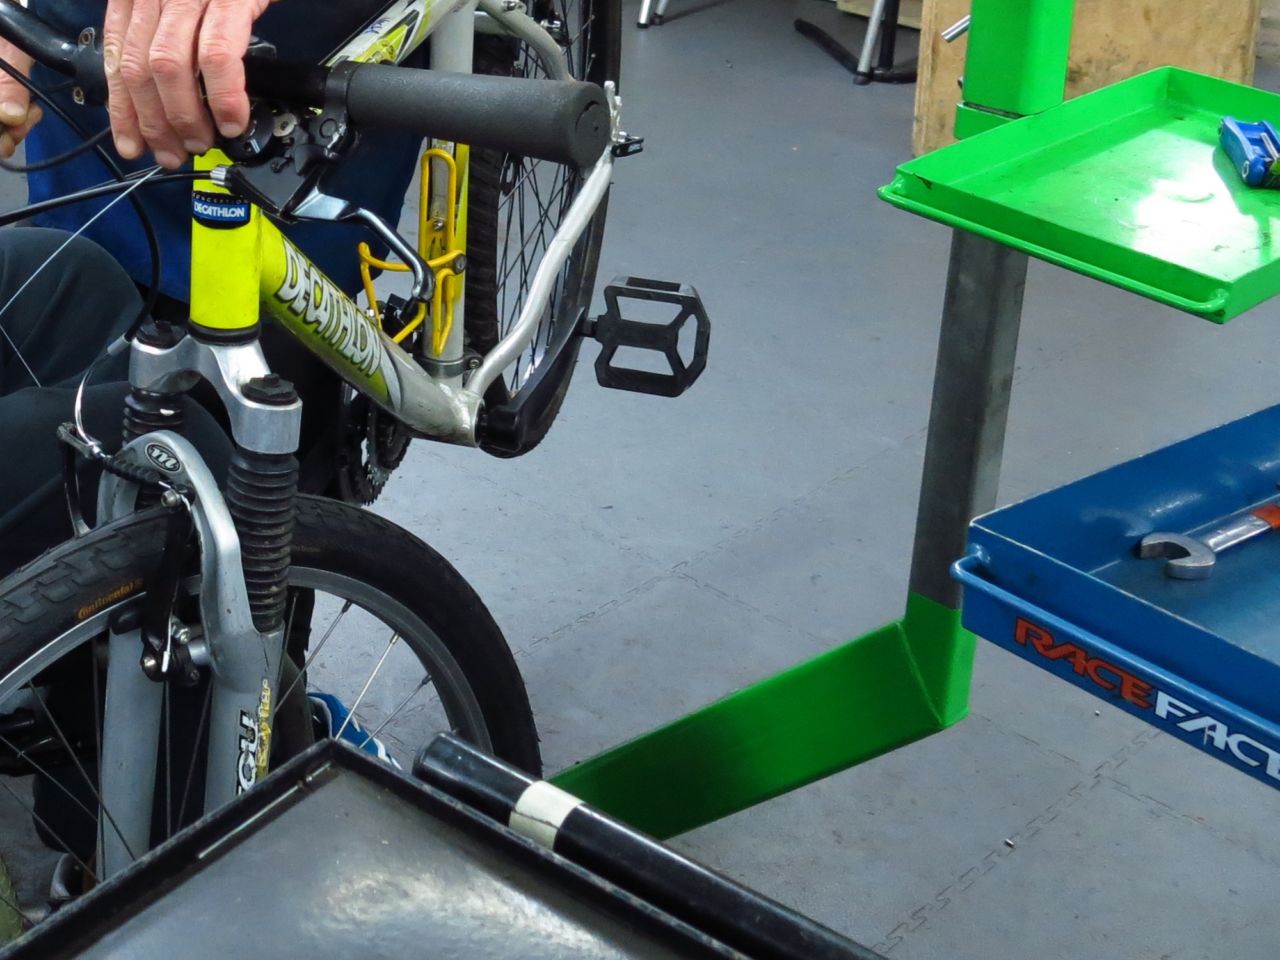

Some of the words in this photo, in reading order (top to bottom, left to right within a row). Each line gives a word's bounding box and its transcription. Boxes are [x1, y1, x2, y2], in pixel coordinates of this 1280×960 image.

[194, 201, 244, 217] DECATHLON
[275, 237, 382, 377] DECATHLON
[1014, 615, 1154, 711] RACE
